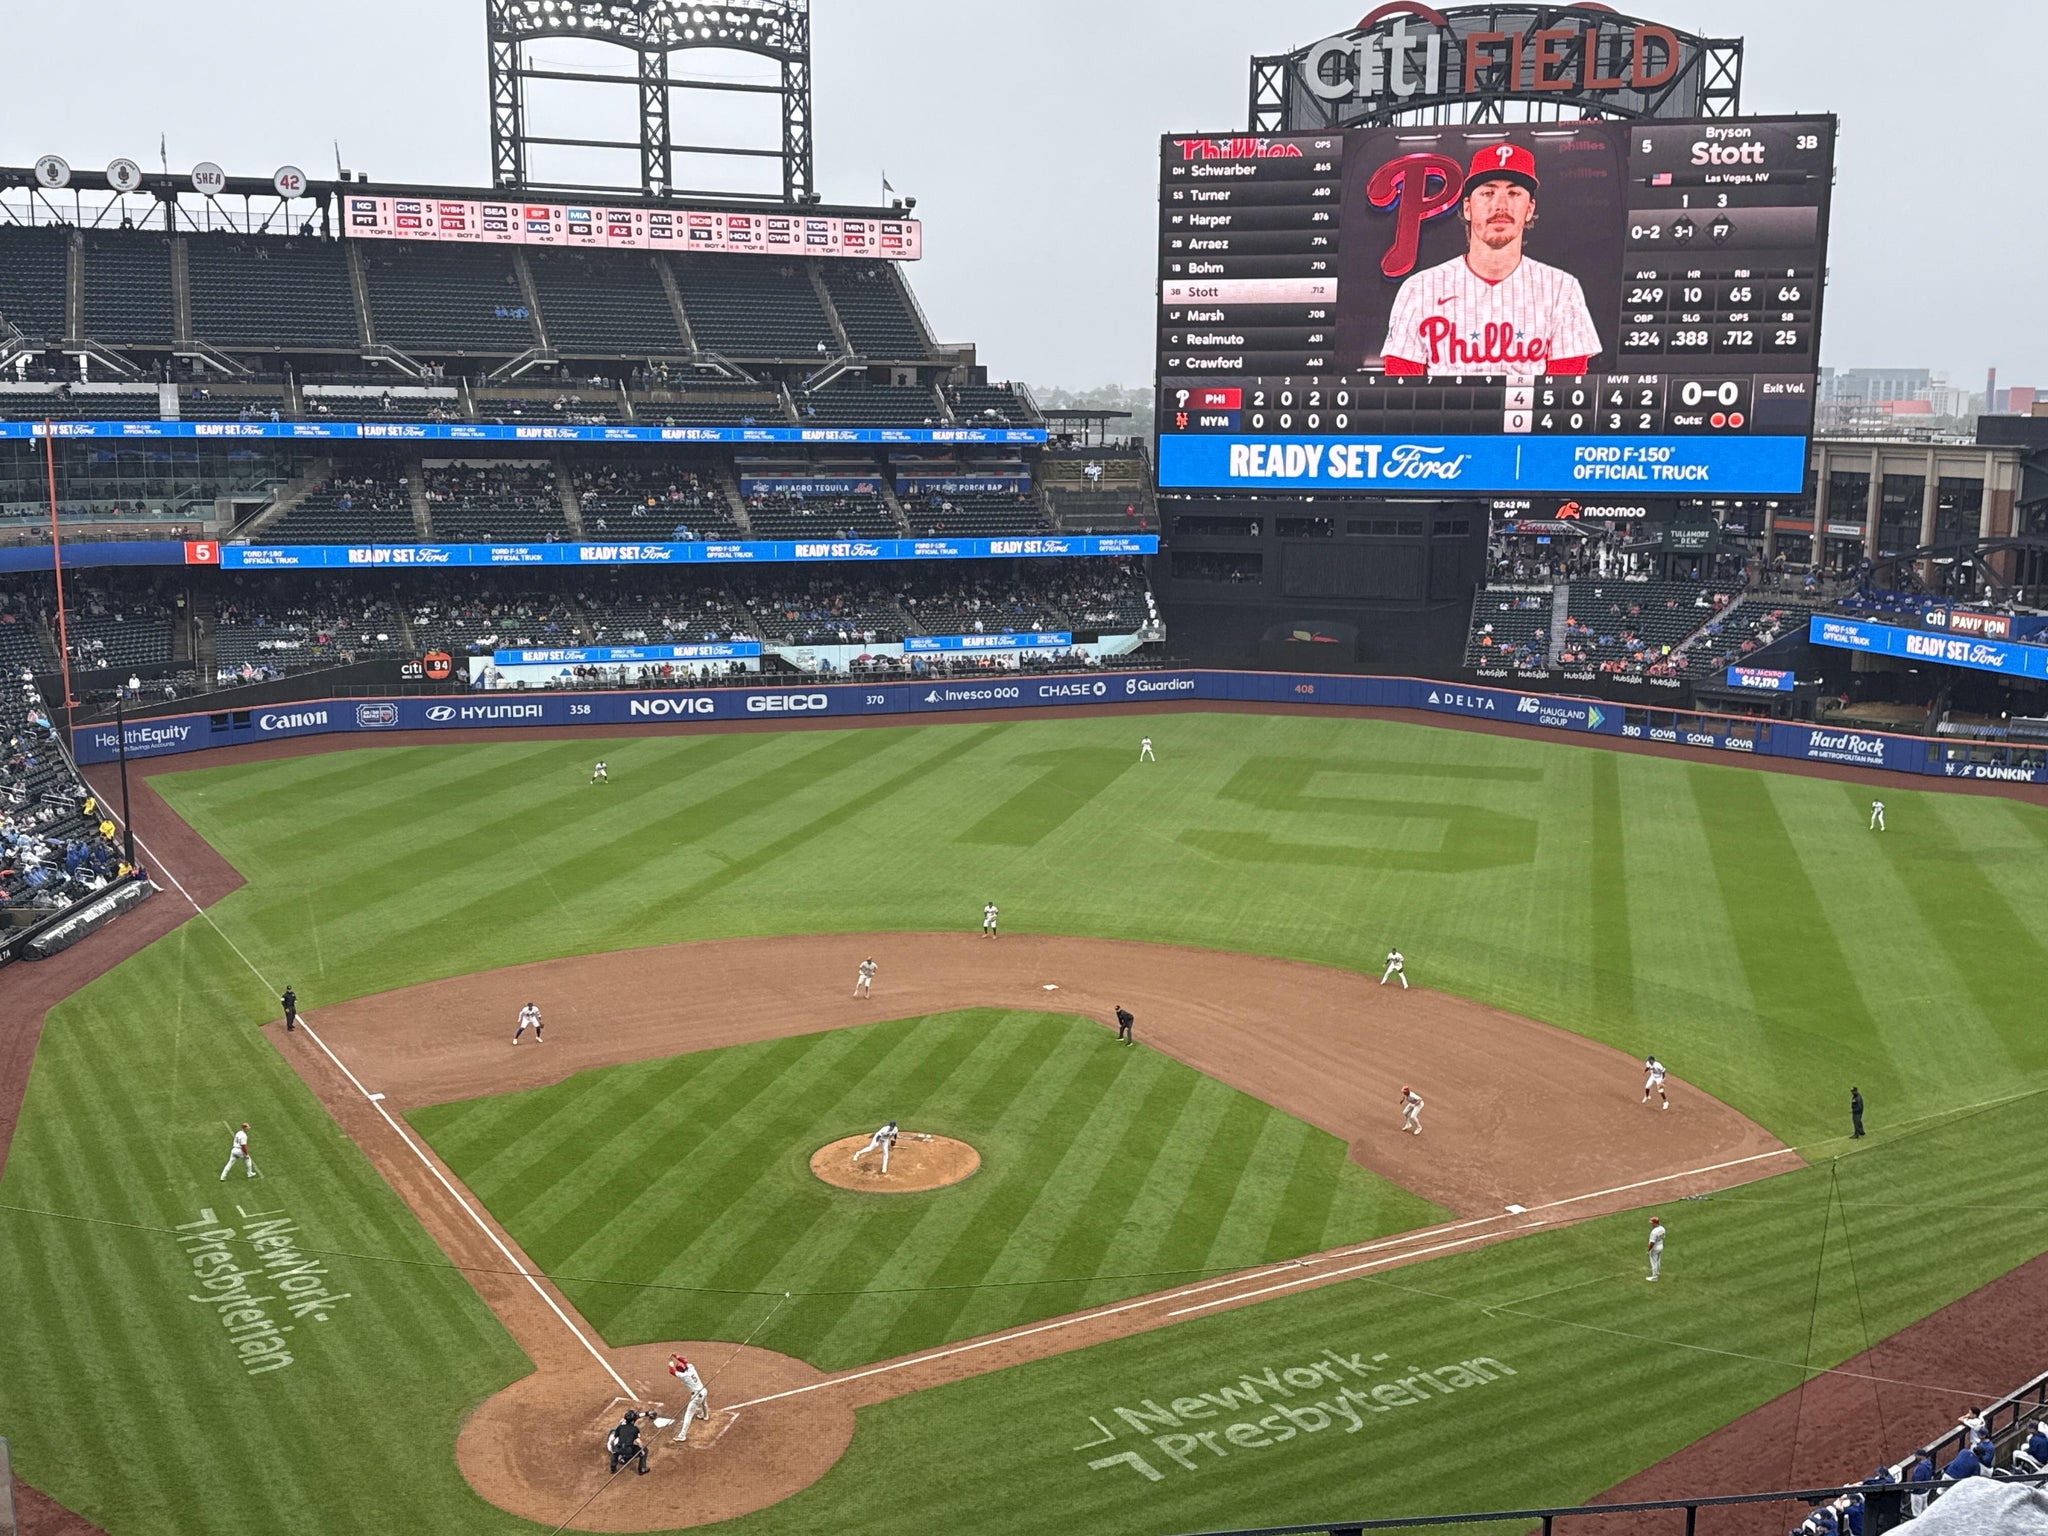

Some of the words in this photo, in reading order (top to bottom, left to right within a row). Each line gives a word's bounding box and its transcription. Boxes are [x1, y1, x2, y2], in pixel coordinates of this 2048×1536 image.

[1306, 18, 1440, 98] citi
[1465, 25, 1680, 94] FIELD
[1706, 127, 1751, 140] Bryson
[1642, 140, 1652, 152] 5
[1796, 136, 1817, 149] 3B
[1691, 141, 1765, 166] Stott
[1191, 165, 1256, 176] Schwarber
[196, 173, 221, 185] SHEA
[280, 175, 299, 190] 42
[1705, 174, 1720, 183] Las
[1723, 174, 1752, 184] Vegas,
[1755, 173, 1769, 182] NV
[1191, 190, 1230, 200] Turner
[1682, 195, 1688, 208] 1
[1717, 194, 1727, 207] 3
[356, 202, 371, 210] KC
[397, 203, 420, 213] CHC
[484, 207, 506, 216] SEA
[357, 216, 373, 224] PIT
[570, 211, 589, 220] MIA
[610, 213, 630, 221] NYY
[651, 215, 671, 224] ATH
[1190, 214, 1231, 226] Harper
[400, 218, 419, 226] CIN
[485, 222, 506, 230] COL
[528, 224, 549, 232] LAD
[845, 224, 863, 232] MIN
[730, 232, 750, 241] HOU
[1631, 226, 1660, 239] 0-2
[1674, 226, 1693, 237] 3-1
[1714, 225, 1728, 236] F7
[1189, 239, 1228, 249] Arraez
[1189, 263, 1223, 273] Bohm
[1637, 271, 1656, 279] AVG
[1735, 270, 1749, 278] RBI
[1787, 269, 1793, 277] R
[1189, 286, 1218, 297] Stott
[1627, 289, 1663, 303] .249
[1684, 289, 1701, 302] 10
[1730, 288, 1751, 302] 65
[1778, 288, 1800, 301] 66
[1187, 310, 1224, 321] Marsh
[1634, 314, 1653, 323] OBP
[1682, 314, 1699, 322] SLG
[1730, 314, 1748, 322] OPS
[1782, 313, 1793, 321] SB
[1187, 334, 1244, 345] Realmuto
[1625, 332, 1659, 346] .324
[1671, 332, 1708, 345] .388
[1723, 332, 1752, 345] .712
[1775, 331, 1796, 345] 25
[1186, 358, 1242, 368] Crawford
[1607, 376, 1629, 384] MVR
[1638, 376, 1657, 384] ABS
[1682, 383, 1738, 406] 0-0
[1763, 384, 1783, 393] Exit
[1787, 384, 1805, 393] Vel.
[1205, 394, 1225, 404] PHI
[1254, 392, 1264, 406] 2
[1281, 392, 1292, 406] 0
[1310, 392, 1320, 405] 2
[1337, 392, 1348, 406] 0
[1514, 391, 1524, 405] 4
[1543, 391, 1553, 405] 5
[1572, 391, 1583, 405] 0
[1610, 391, 1622, 405] 4
[1641, 391, 1652, 405] 2
[1201, 416, 1229, 426] NYM
[1253, 414, 1263, 428] 0
[1280, 414, 1291, 428] 0
[1308, 414, 1319, 428] 0
[1336, 414, 1347, 428] 0
[1513, 414, 1523, 427] 0
[1541, 414, 1553, 427] 4
[1571, 414, 1582, 427] 0
[1610, 415, 1620, 427] 3
[1640, 415, 1650, 427] 2
[1675, 415, 1702, 425] Outs:
[1575, 447, 1620, 461] FORD
[1230, 445, 1322, 477] READY
[1329, 445, 1382, 477] SET
[1574, 465, 1649, 480] OFFICIAL
[1653, 466, 1708, 480] TRUCK
[1493, 501, 1516, 509] 02:42
[1518, 501, 1530, 509] PM
[1584, 506, 1645, 517] moomoo
[1671, 530, 1709, 539] TULLAMORE
[195, 545, 209, 560] 5
[349, 549, 390, 563] READY
[393, 549, 415, 562] SET
[416, 549, 450, 563] Ford
[1926, 610, 1945, 626] citi
[1907, 635, 1944, 655] READY
[1947, 641, 1970, 661] SET
[1970, 644, 2004, 666] Ford
[401, 660, 422, 675] citi
[434, 660, 448, 671] 94
[1138, 679, 1194, 693] Guardian
[1741, 676, 1779, 688] $47,170
[945, 688, 991, 702] Invesco
[994, 687, 1019, 699] QQQ
[1039, 684, 1091, 697] CHASE
[1295, 684, 1314, 694] 408
[747, 693, 827, 712] GEICO
[866, 694, 884, 705] 370
[1444, 693, 1495, 711] DELTA
[461, 704, 542, 719] HYUNDAI
[570, 704, 591, 715] 358
[630, 698, 714, 715] NOVIG
[1540, 706, 1585, 720] HAUGLAND
[260, 710, 328, 731] Canon
[1540, 715, 1568, 727] GROUP
[1622, 725, 1641, 737] 380
[1810, 731, 1846, 750] Hard
[1848, 736, 1884, 757] Rock
[1819, 751, 1865, 762] METROPOLITAN
[1867, 755, 1884, 765] PARK
[1976, 766, 2035, 782] DUNKIN'
[176, 1227, 295, 1375] Presbyterian
[1152, 1356, 1518, 1471] Presbyterian
